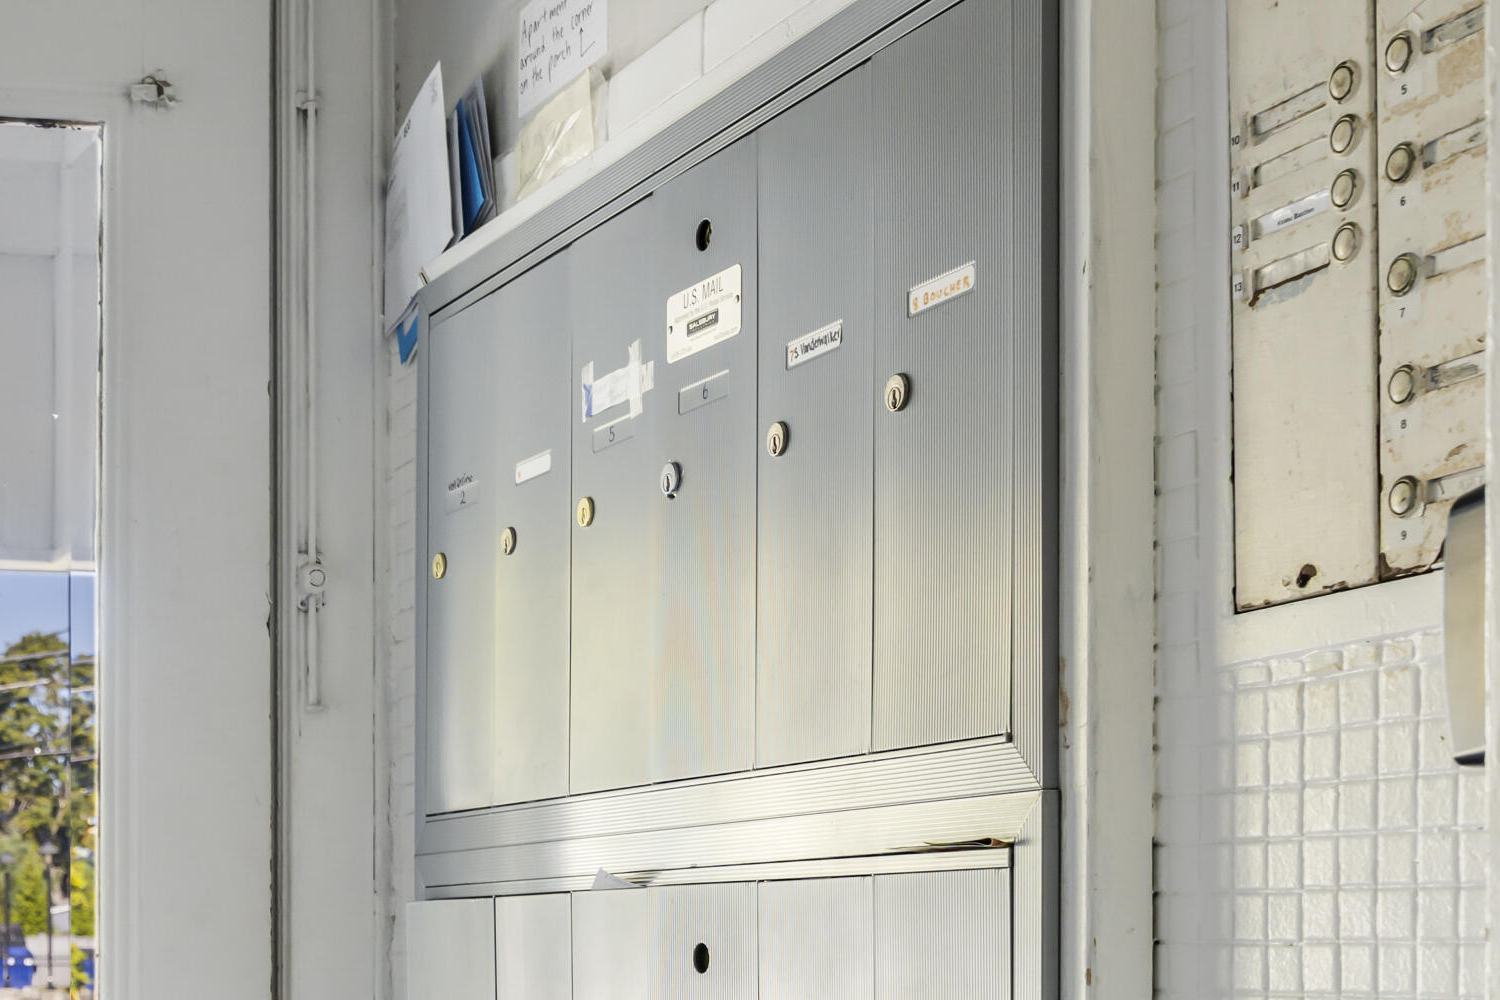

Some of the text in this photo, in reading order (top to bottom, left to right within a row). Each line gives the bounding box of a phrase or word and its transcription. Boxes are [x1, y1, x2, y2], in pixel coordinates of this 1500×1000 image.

[520, 0, 593, 70] around the corner
[548, 40, 571, 83] porch
[1231, 135, 1240, 146] 10
[1232, 182, 1240, 193] 11
[1233, 233, 1242, 245] 12
[683, 288, 700, 309] U.S.
[702, 276, 723, 302] MAIL
[1234, 282, 1242, 293] 13
[703, 382, 708, 400] 6
[609, 426, 615, 442] 5
